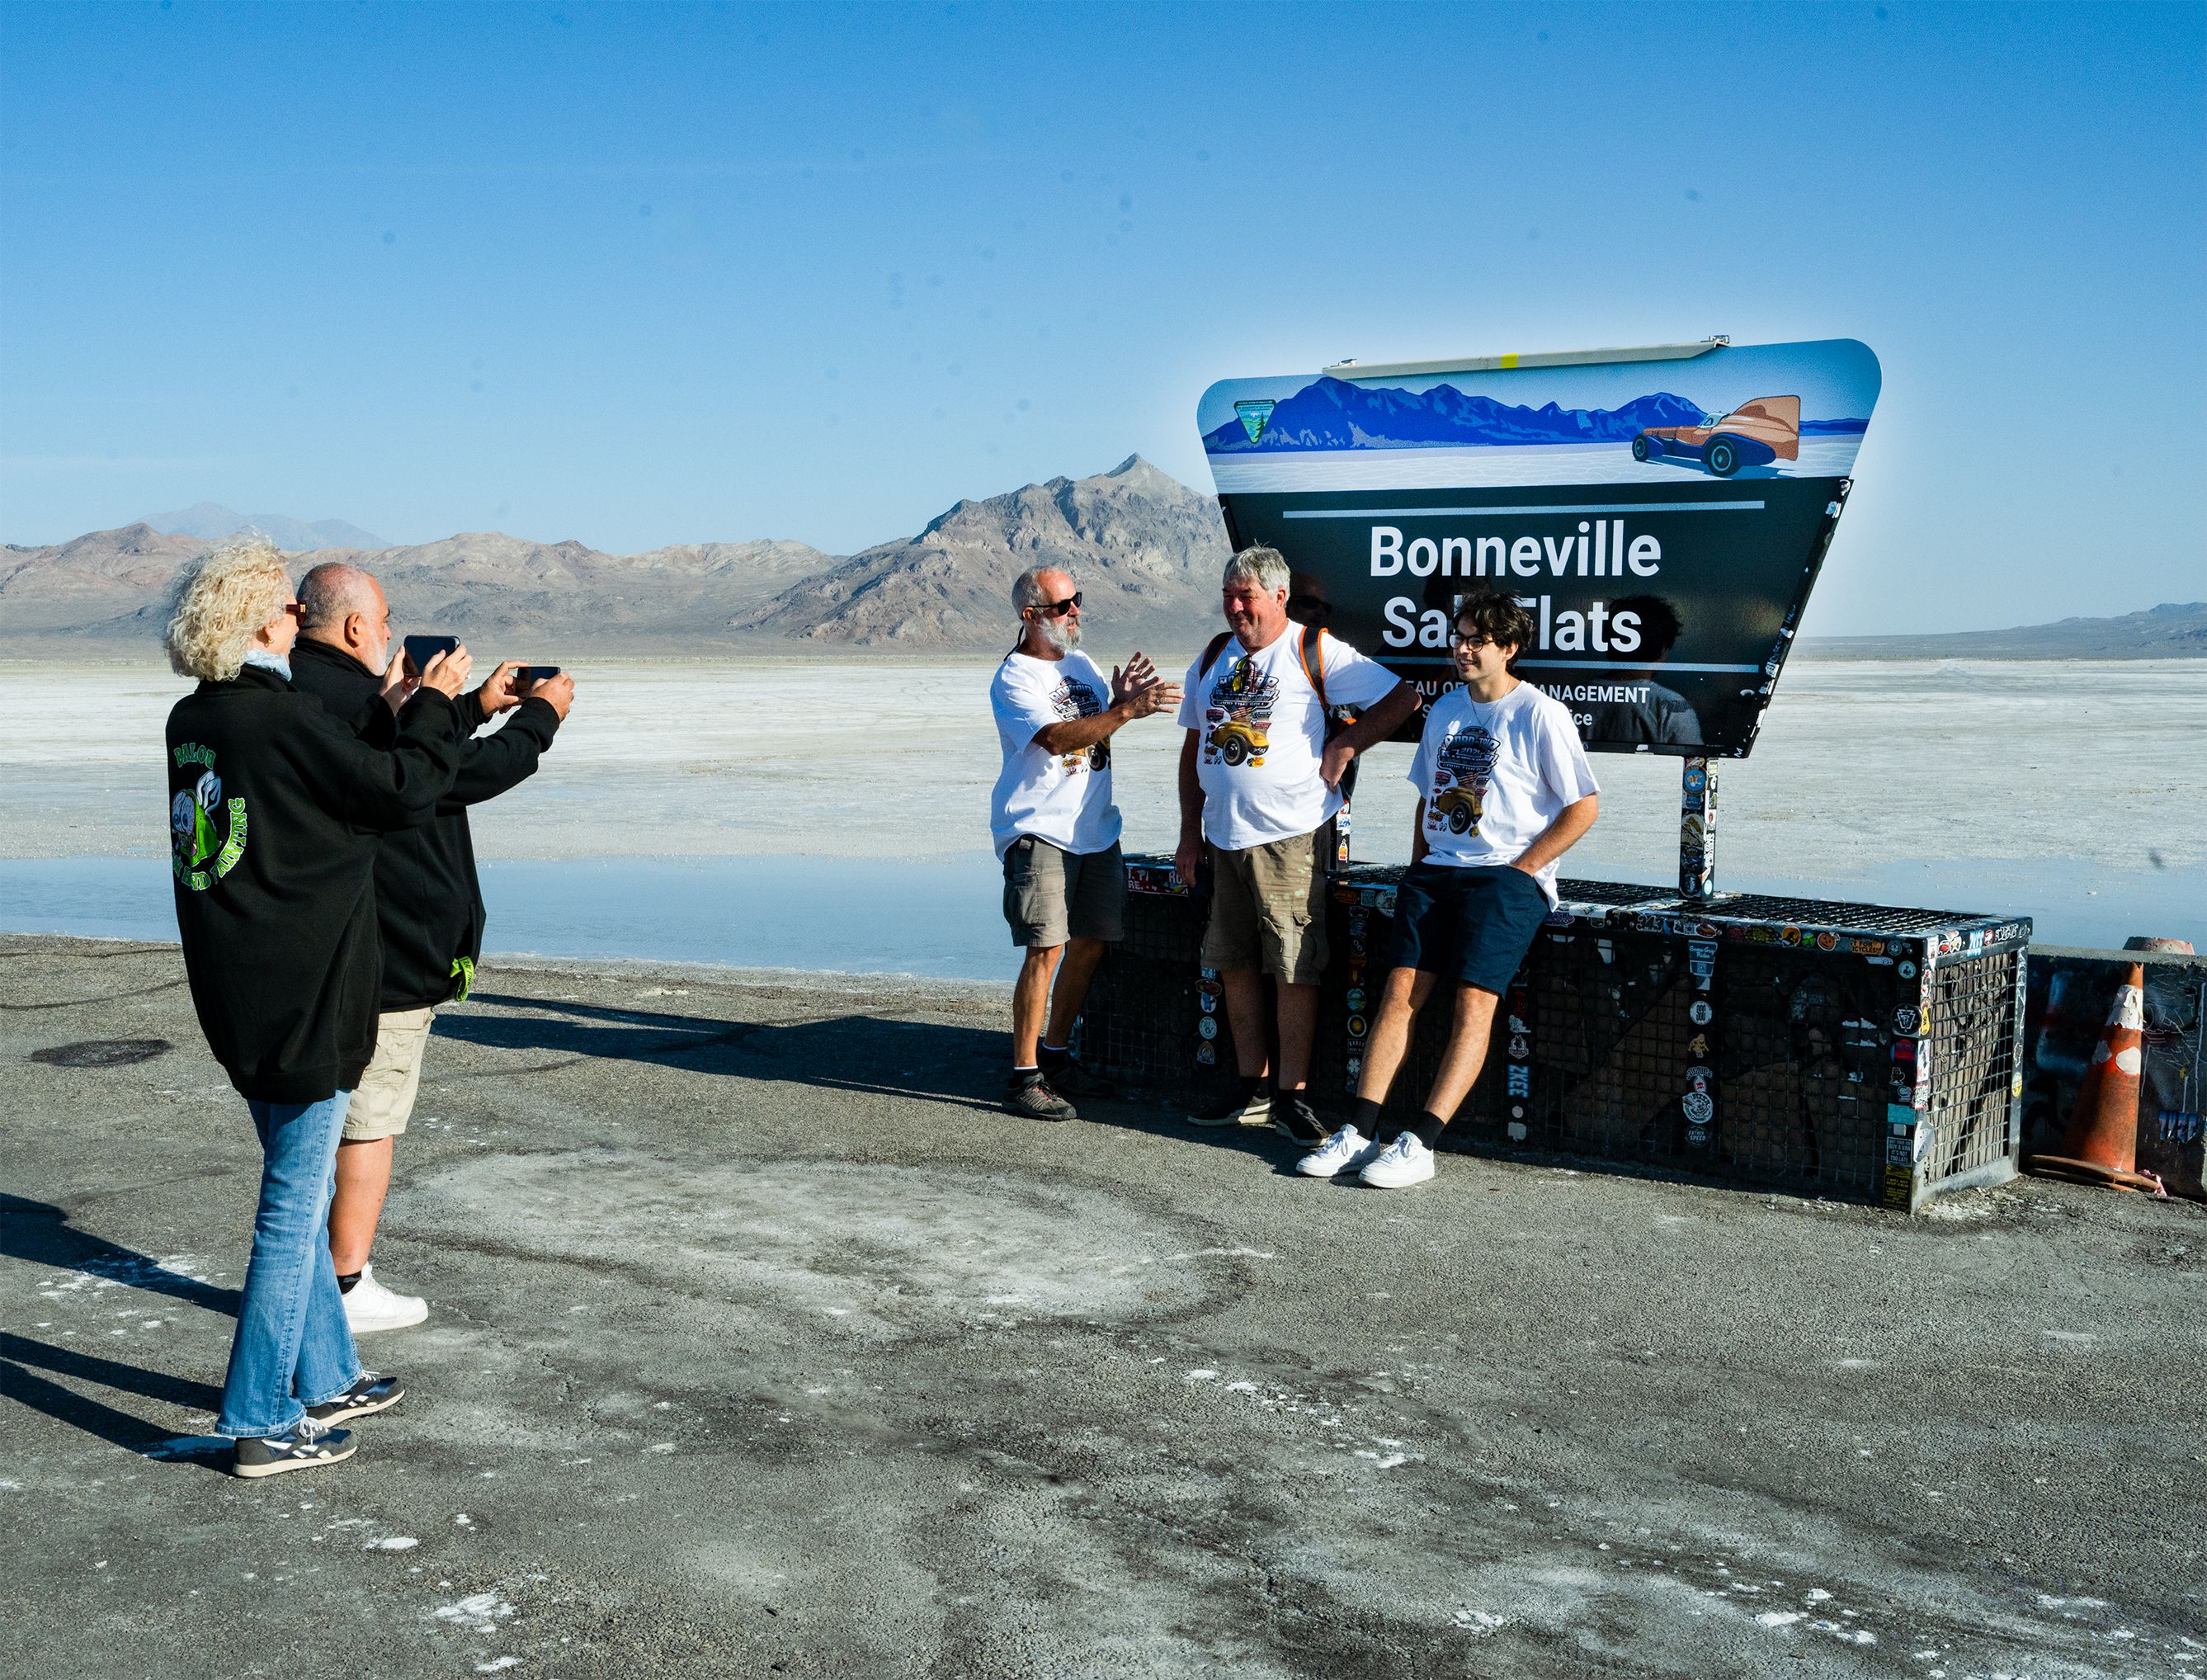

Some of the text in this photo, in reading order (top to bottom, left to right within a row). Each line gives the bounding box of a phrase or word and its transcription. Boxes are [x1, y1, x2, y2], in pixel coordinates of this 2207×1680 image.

[1370, 520, 1661, 578] Bonneville
[1511, 593, 1642, 653] lats
[1531, 684, 1650, 704] ANAGEMENT
[173, 743, 216, 770] BALOU
